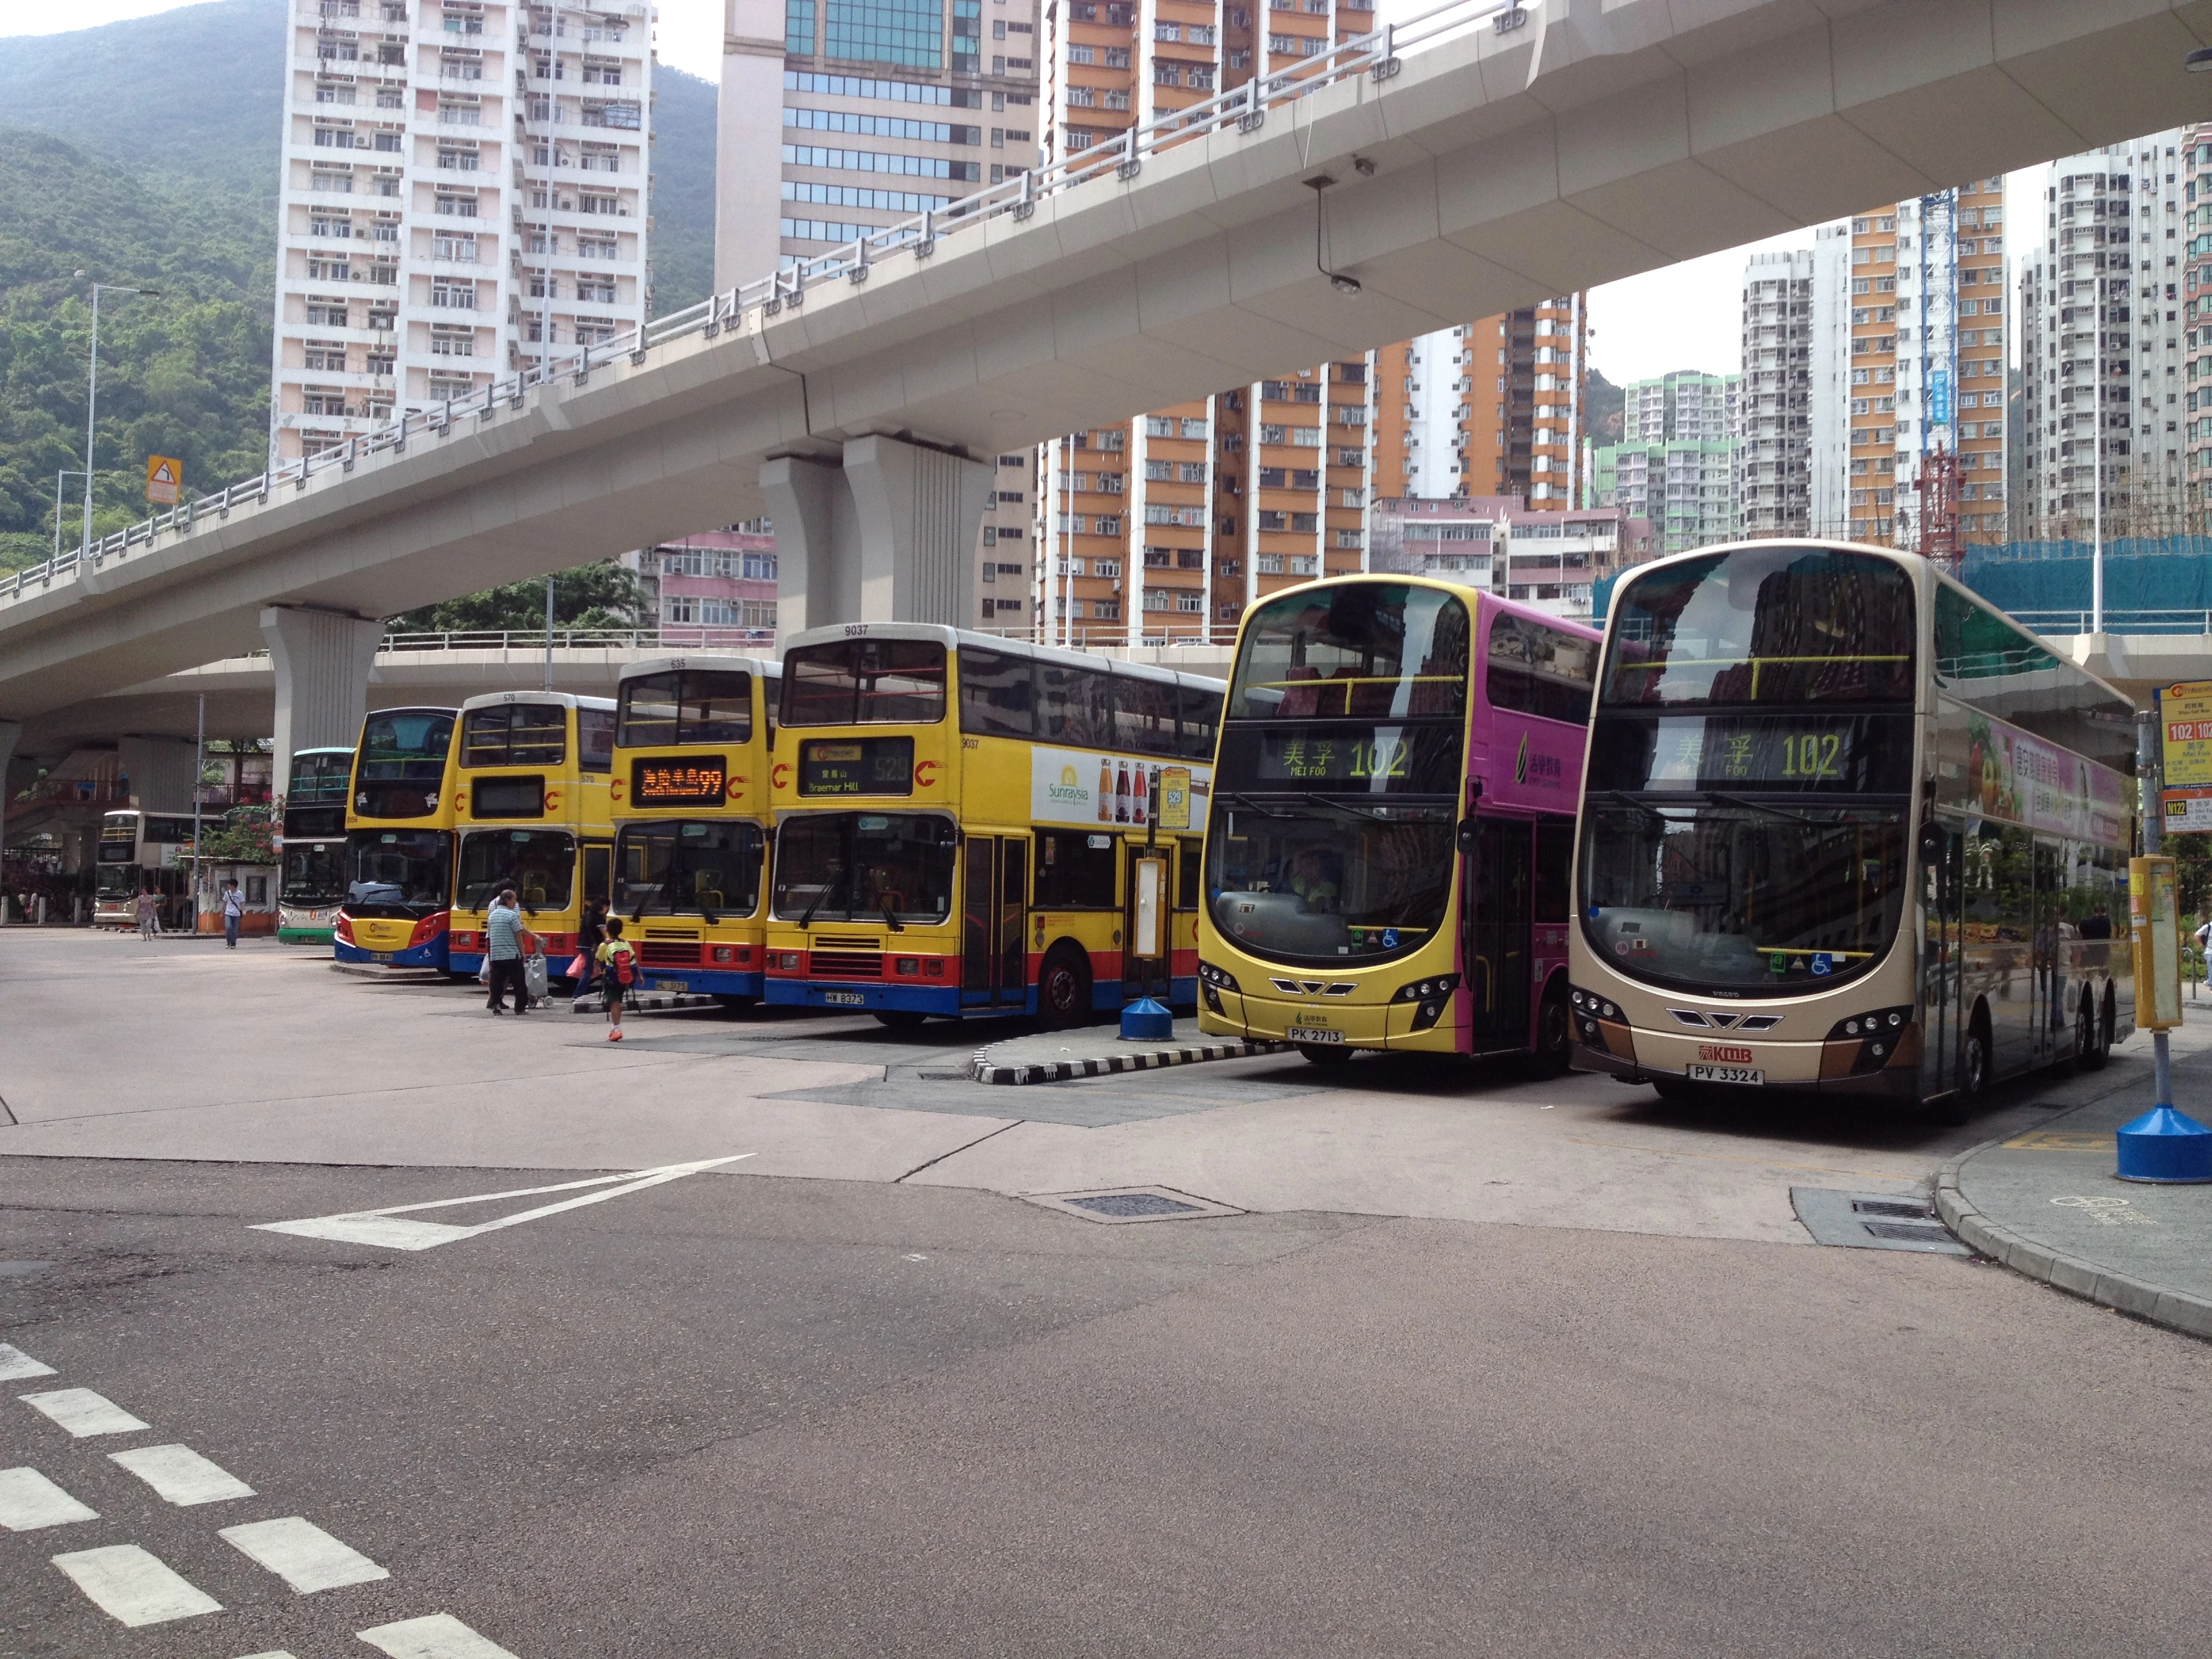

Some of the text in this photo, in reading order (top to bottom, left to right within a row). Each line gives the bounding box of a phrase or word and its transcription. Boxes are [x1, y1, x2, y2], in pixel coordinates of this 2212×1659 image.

[844, 625, 868, 636] 9037
[671, 659, 685, 669] 635
[504, 693, 515, 702] 570
[2171, 724, 2193, 740] 102
[962, 738, 979, 749] 9037
[1283, 741, 1336, 766] 美孚
[1350, 739, 1408, 777] 102
[1781, 734, 1840, 775] 102
[1290, 766, 1326, 776] MEI FOO
[1725, 765, 1748, 777] FOO
[699, 771, 722, 795] 99
[808, 782, 859, 792] Braemar Hill
[1049, 783, 1088, 806] Sunraysia
[1168, 792, 1181, 803] 529
[2167, 802, 2186, 815] N122
[841, 994, 863, 1004] 8373
[1291, 1029, 1340, 1042] PK 2713
[1714, 1046, 1753, 1064] KMB
[1694, 1066, 1759, 1083] PV 3324
